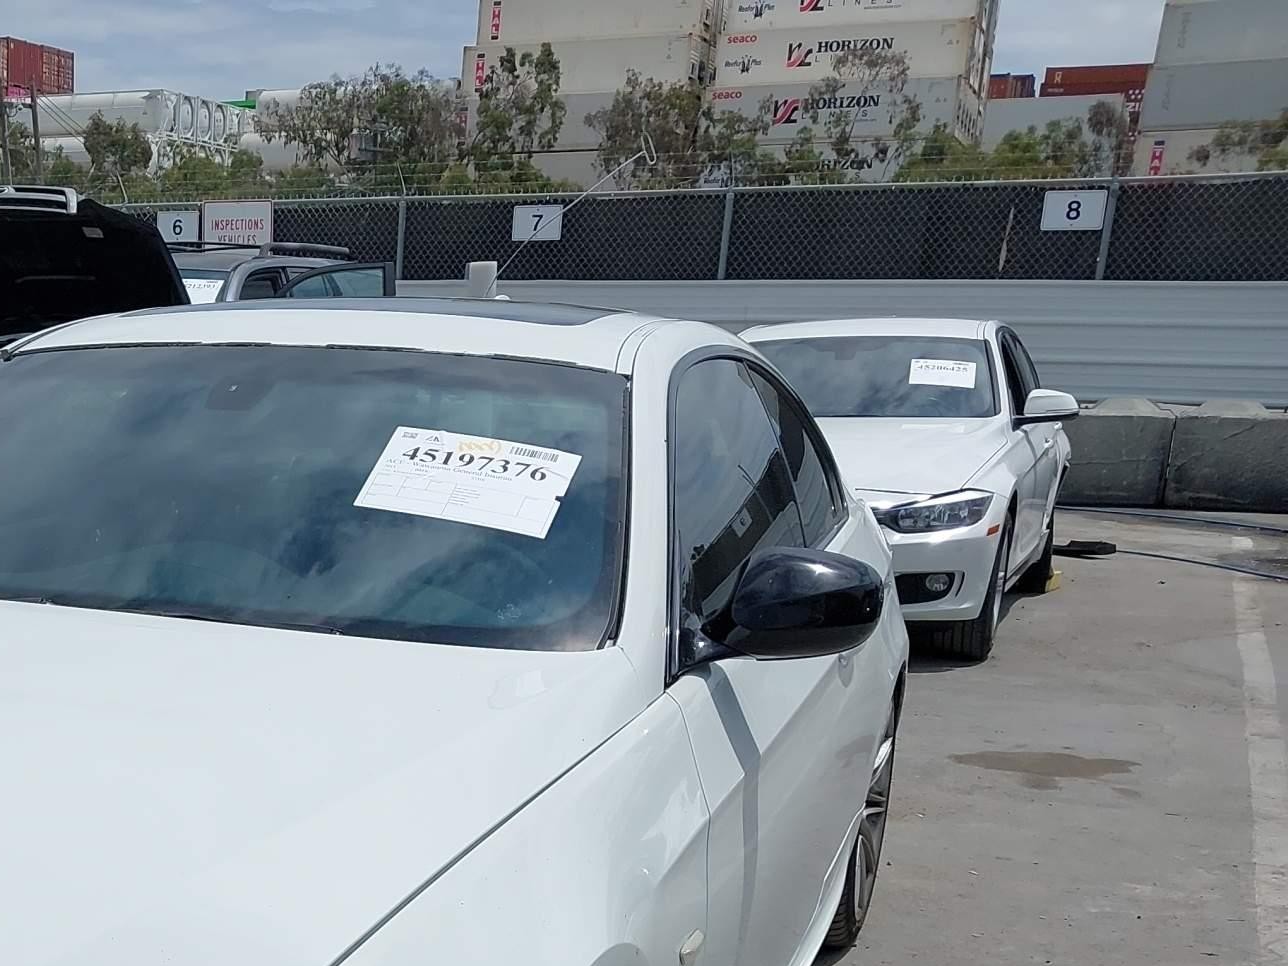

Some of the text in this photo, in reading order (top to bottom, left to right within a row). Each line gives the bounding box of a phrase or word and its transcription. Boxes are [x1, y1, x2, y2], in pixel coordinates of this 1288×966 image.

[491, 8, 501, 33] TAL
[727, 34, 758, 44] seaco
[816, 37, 895, 53] HORIZON
[475, 61, 485, 86] TAL
[712, 90, 743, 101] seaco
[1066, 200, 1081, 220] 8
[172, 219, 183, 236] 6
[211, 218, 265, 231] INSPECTIONS
[532, 214, 543, 231] 7
[217, 234, 257, 245] VEHICLES
[402, 446, 547, 482] 45197376
